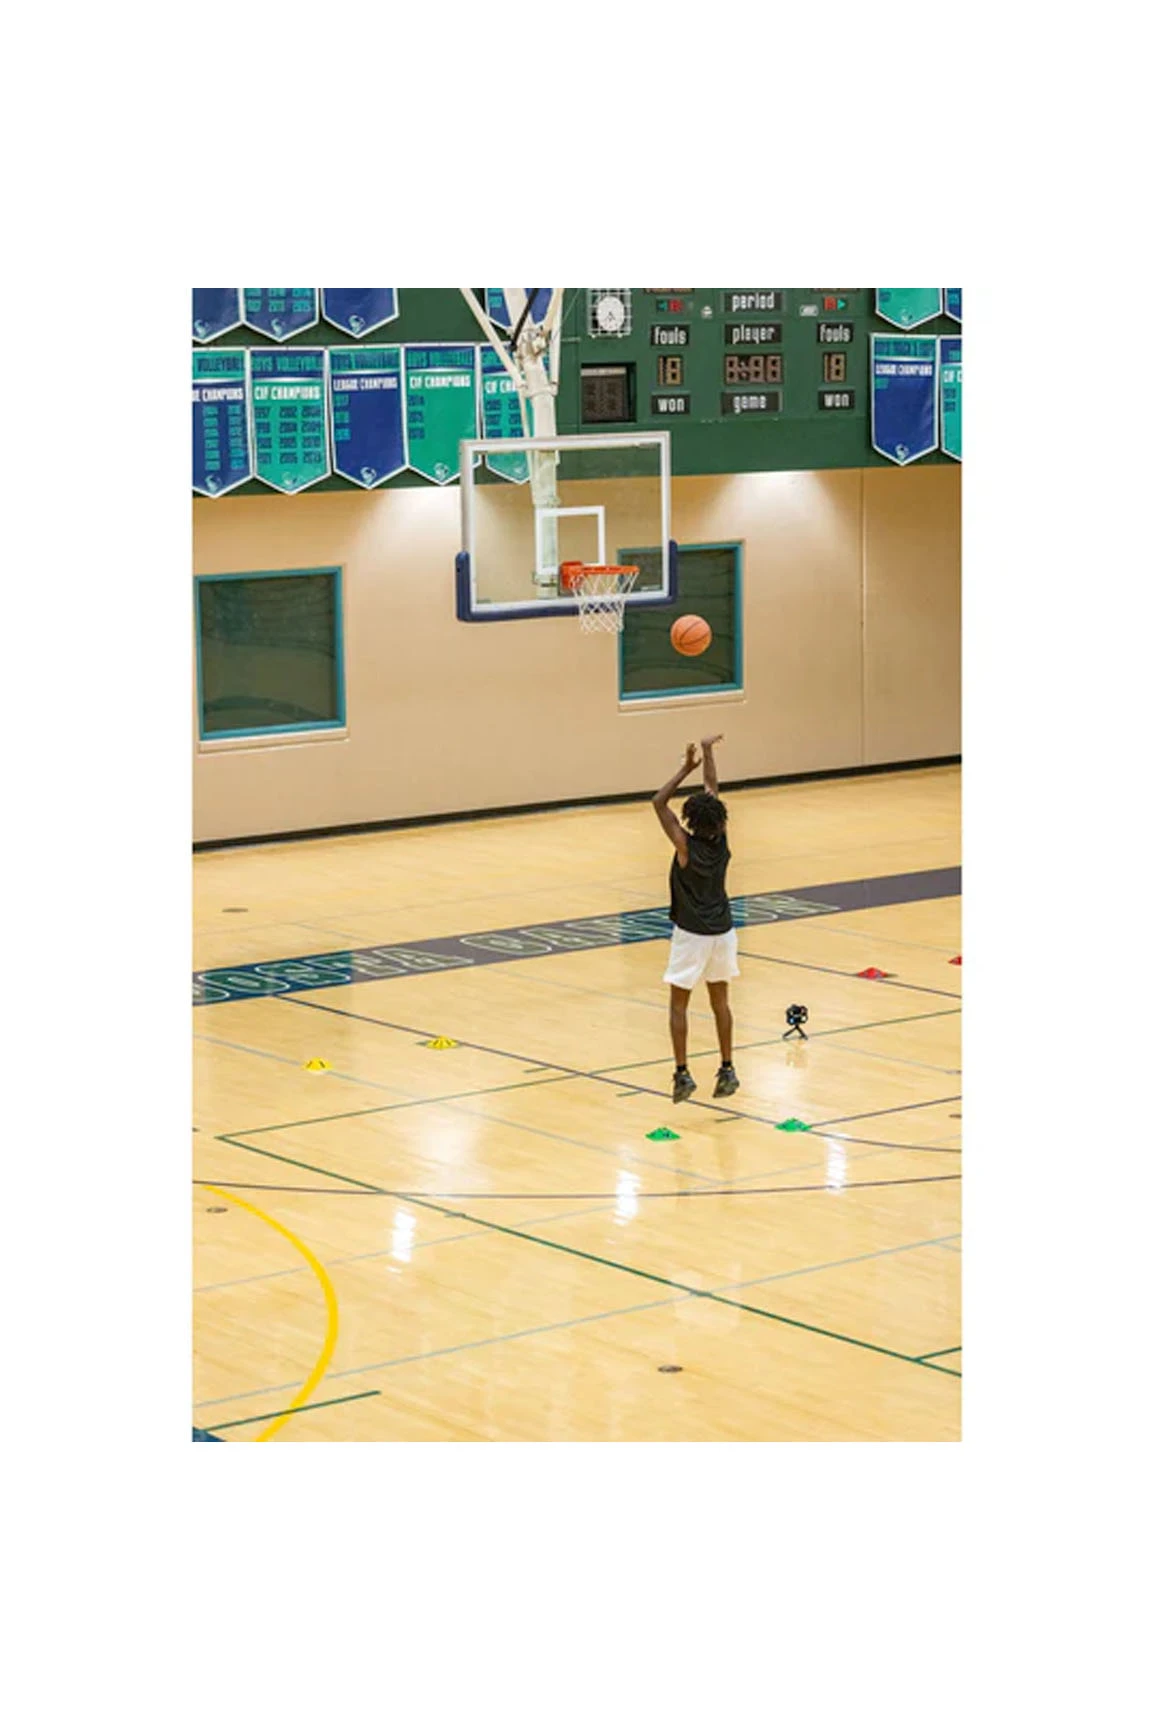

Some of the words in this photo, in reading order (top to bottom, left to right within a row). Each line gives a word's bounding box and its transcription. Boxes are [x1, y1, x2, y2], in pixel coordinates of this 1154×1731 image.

[732, 291, 775, 312] period
[654, 326, 687, 344] fouls
[732, 324, 775, 344] player
[820, 324, 850, 342] fouls
[333, 379, 358, 391] LEAGUE
[360, 377, 397, 390] CHAMPIONS
[410, 376, 422, 389] CIF
[425, 375, 471, 388] CHAMPIONS
[202, 388, 244, 402] CHAMPIONS
[255, 386, 269, 400] CIF
[271, 386, 321, 400] CHAMPIONS
[824, 393, 850, 407] won
[657, 398, 685, 412] won
[733, 395, 767, 414] game
